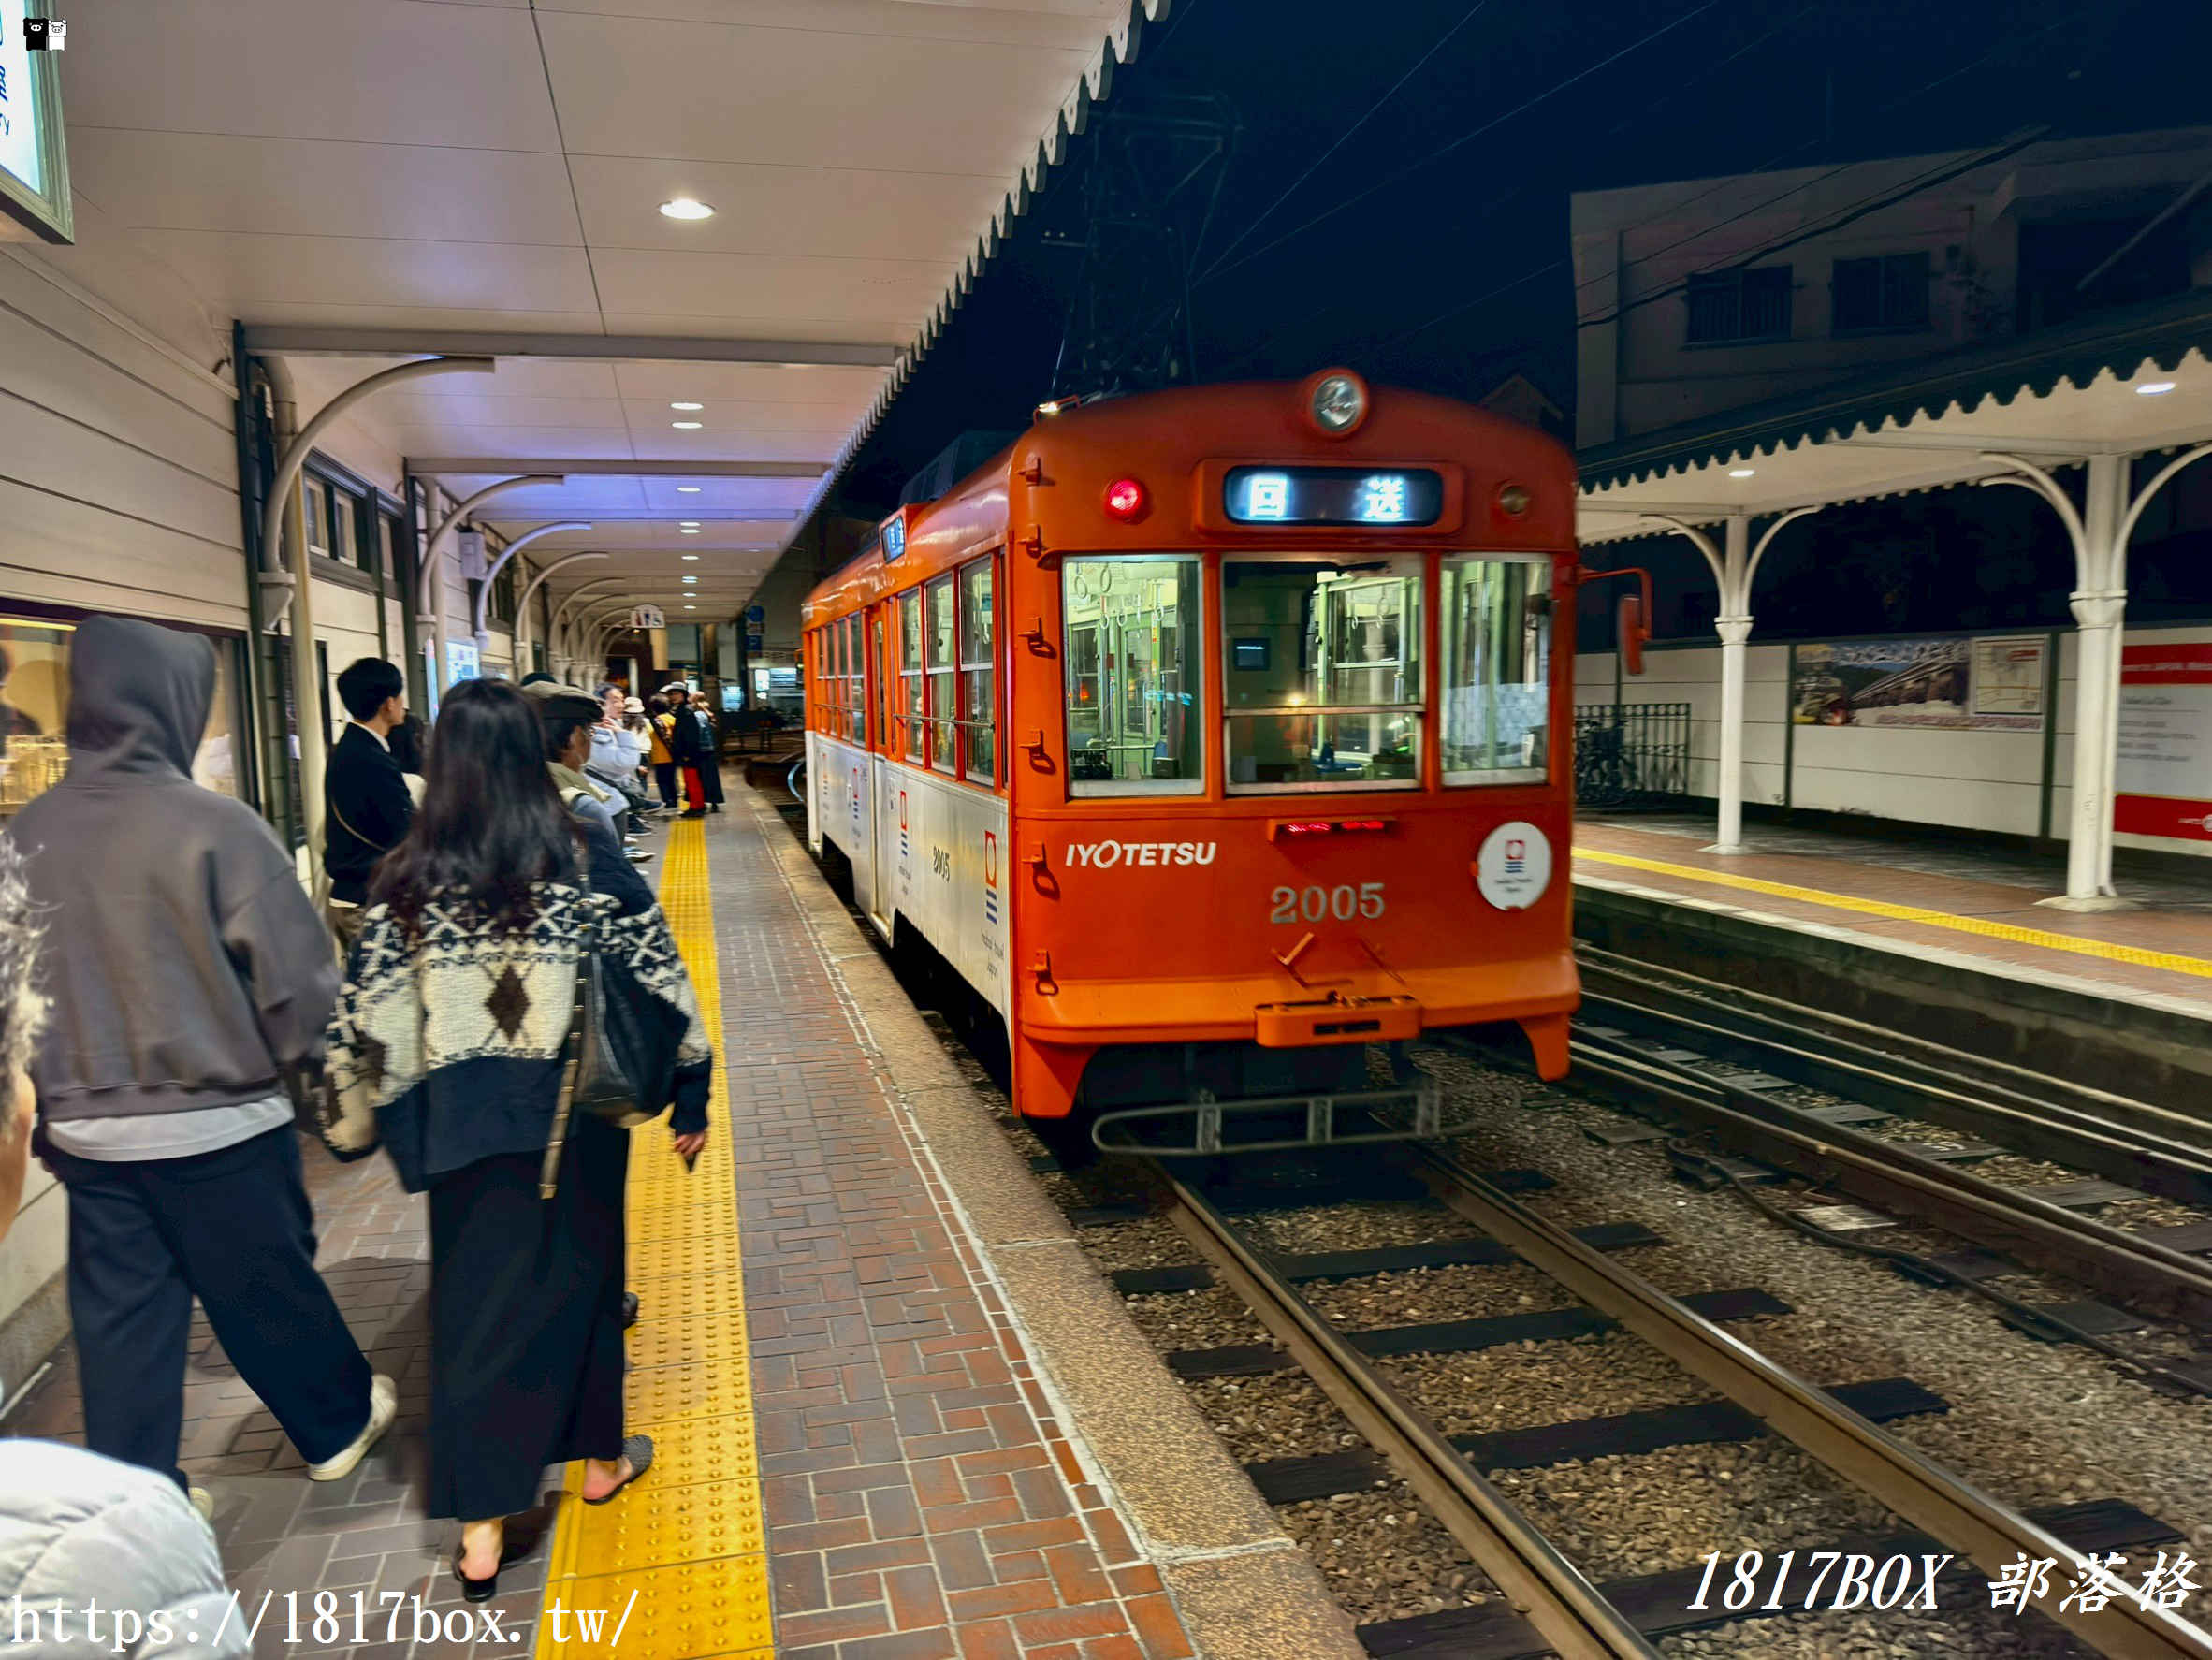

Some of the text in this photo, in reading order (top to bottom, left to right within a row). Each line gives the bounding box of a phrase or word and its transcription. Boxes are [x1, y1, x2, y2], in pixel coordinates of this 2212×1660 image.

[933, 845, 951, 884] 2005
[1065, 839, 1216, 869] IYOTETSU
[1271, 882, 1385, 924] 2005
